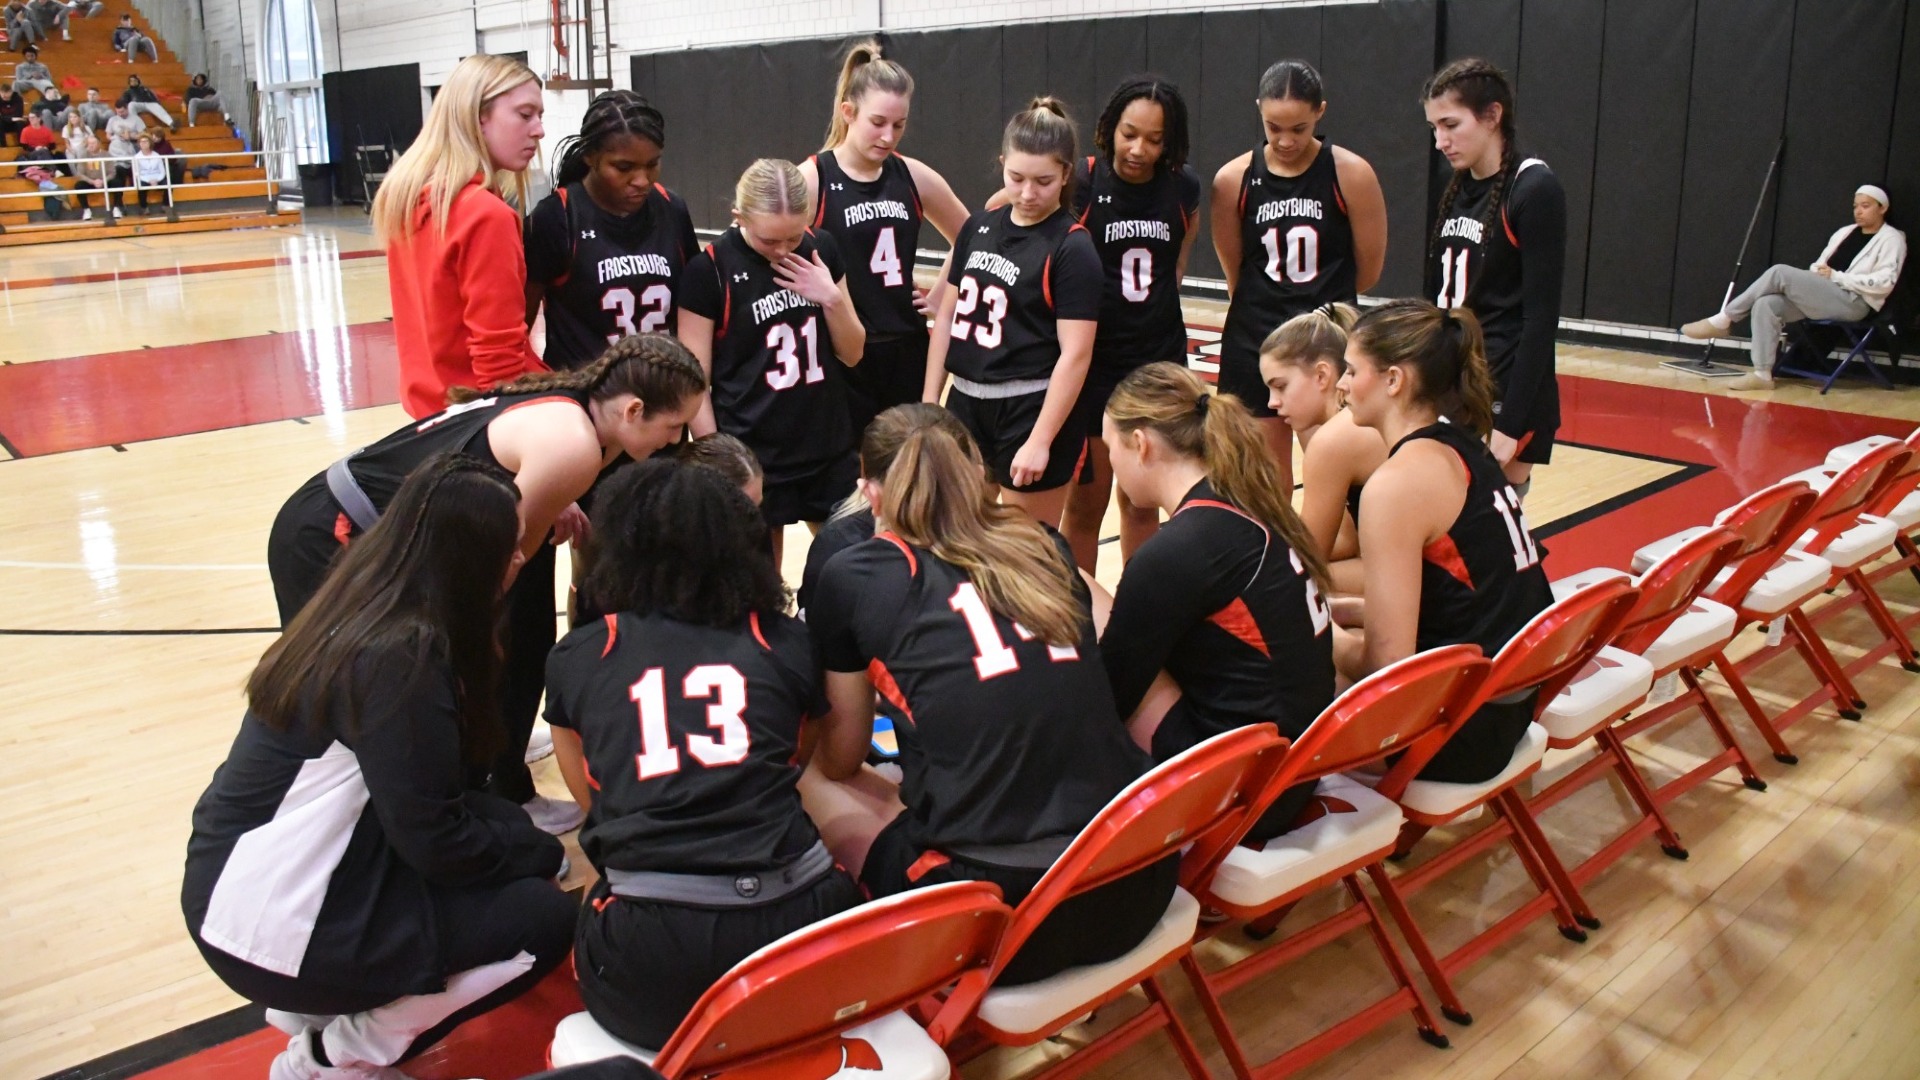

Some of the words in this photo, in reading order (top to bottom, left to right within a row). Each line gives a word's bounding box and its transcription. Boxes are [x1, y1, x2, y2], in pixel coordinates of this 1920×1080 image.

[844, 200, 909, 228] FROSTBURG
[1105, 219, 1171, 243] FROSTBURG
[1256, 197, 1322, 224] FROSTBURG
[597, 253, 671, 284] FROSTBURG
[870, 226, 904, 288] 4
[965, 251, 1021, 287] FROSTBURG
[1121, 247, 1154, 303] 0
[1261, 225, 1319, 284] 10
[1437, 246, 1470, 309] 11
[601, 285, 672, 346] 32
[752, 289, 821, 326] FROSTBU
[951, 275, 1009, 350] 23
[764, 316, 825, 391] 31
[1493, 485, 1540, 572] 12
[948, 581, 1081, 682] 1
[628, 663, 752, 781] 13
